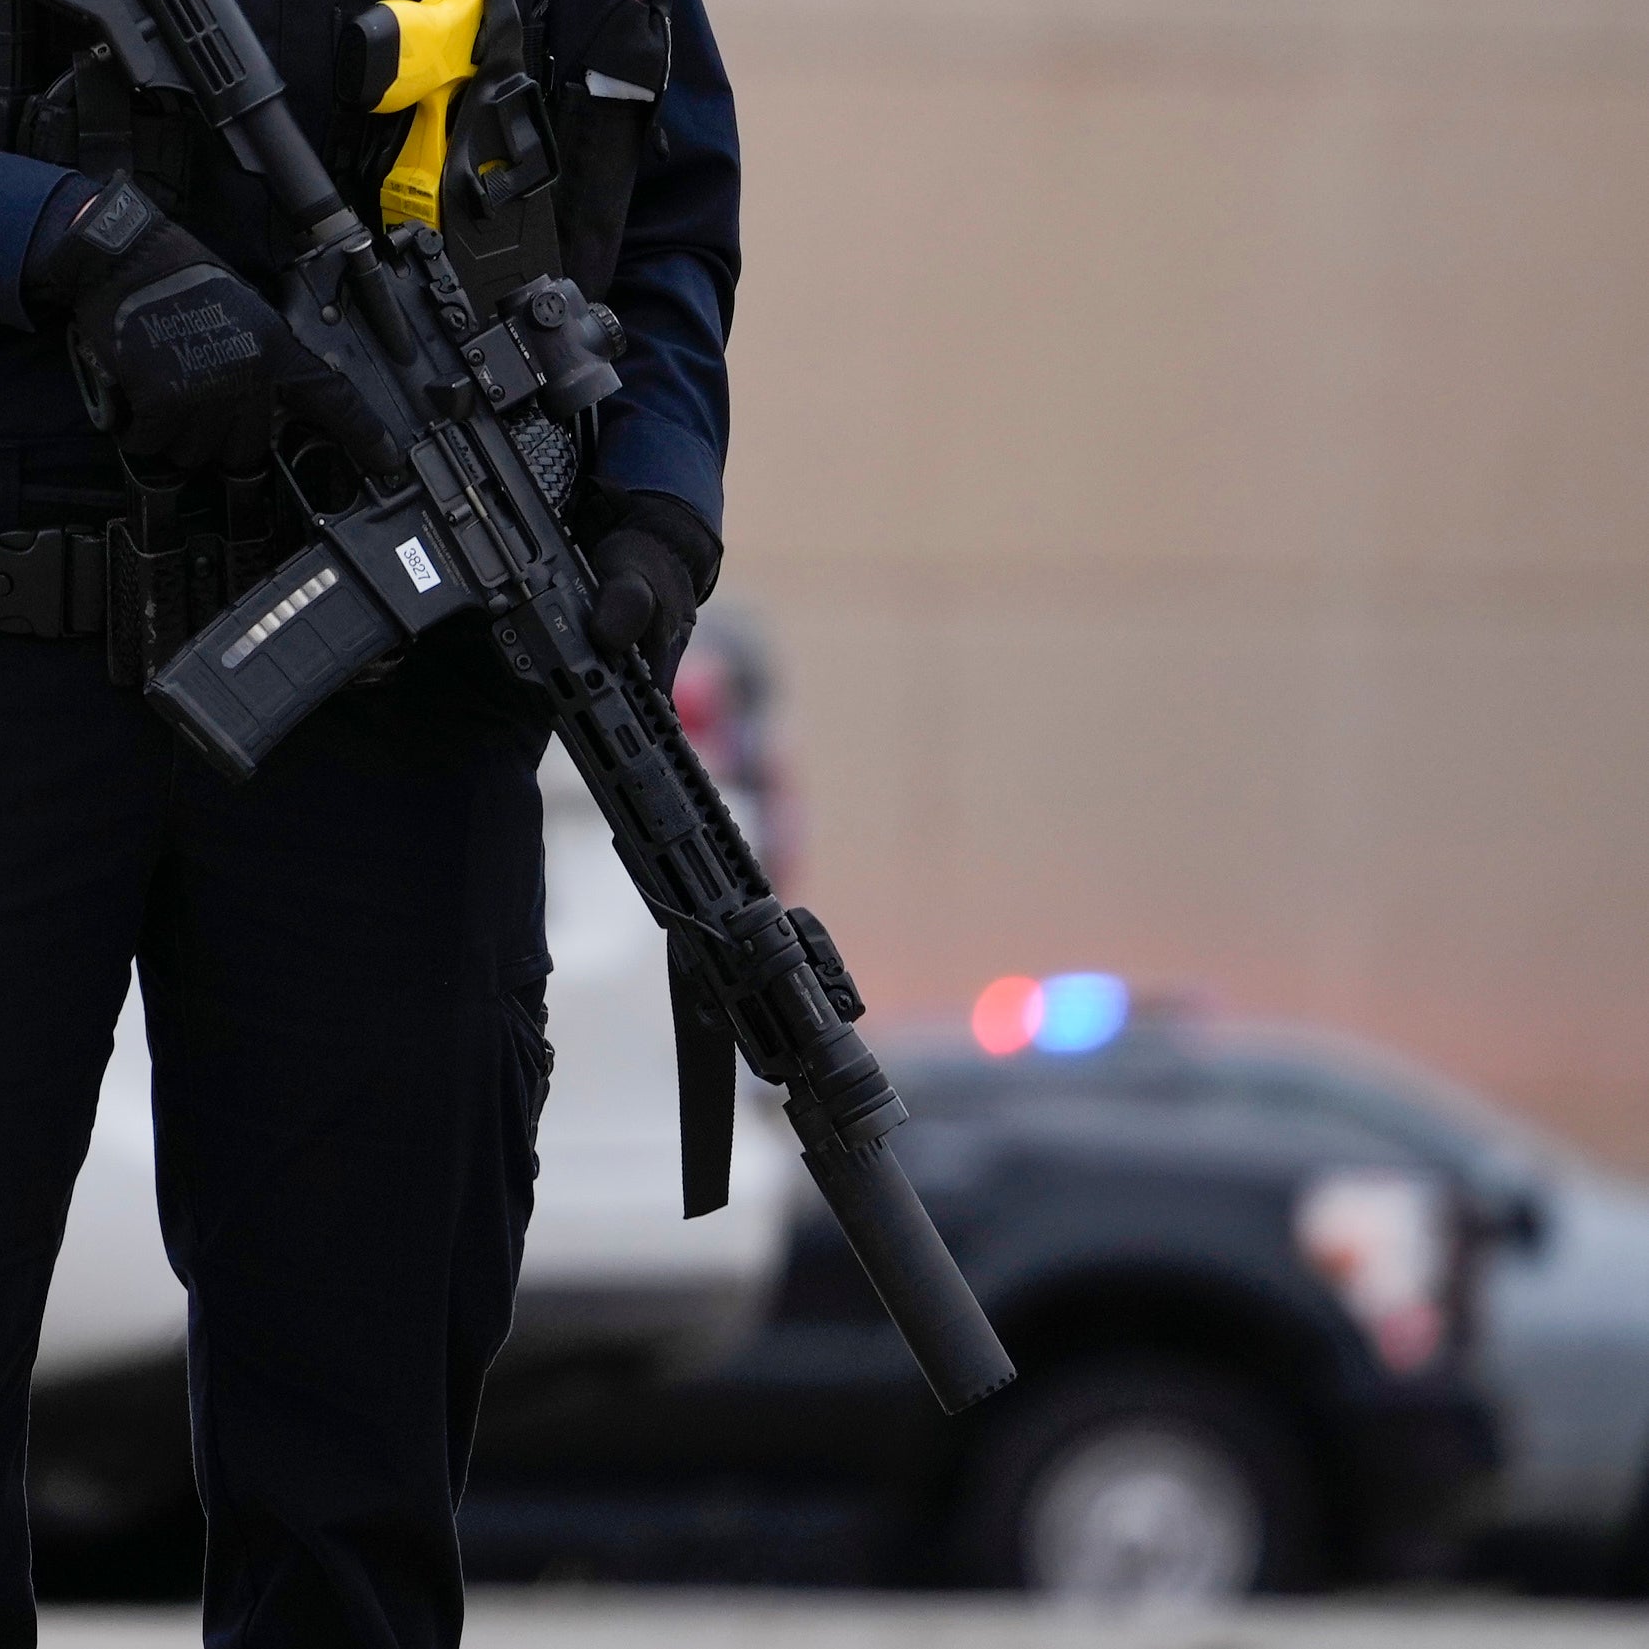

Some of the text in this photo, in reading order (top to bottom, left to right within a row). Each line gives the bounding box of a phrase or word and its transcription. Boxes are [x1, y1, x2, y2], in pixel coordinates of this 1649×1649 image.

[138, 299, 232, 349] Mechanix
[171, 326, 262, 380] Mechanix
[404, 547, 431, 580] 3827
